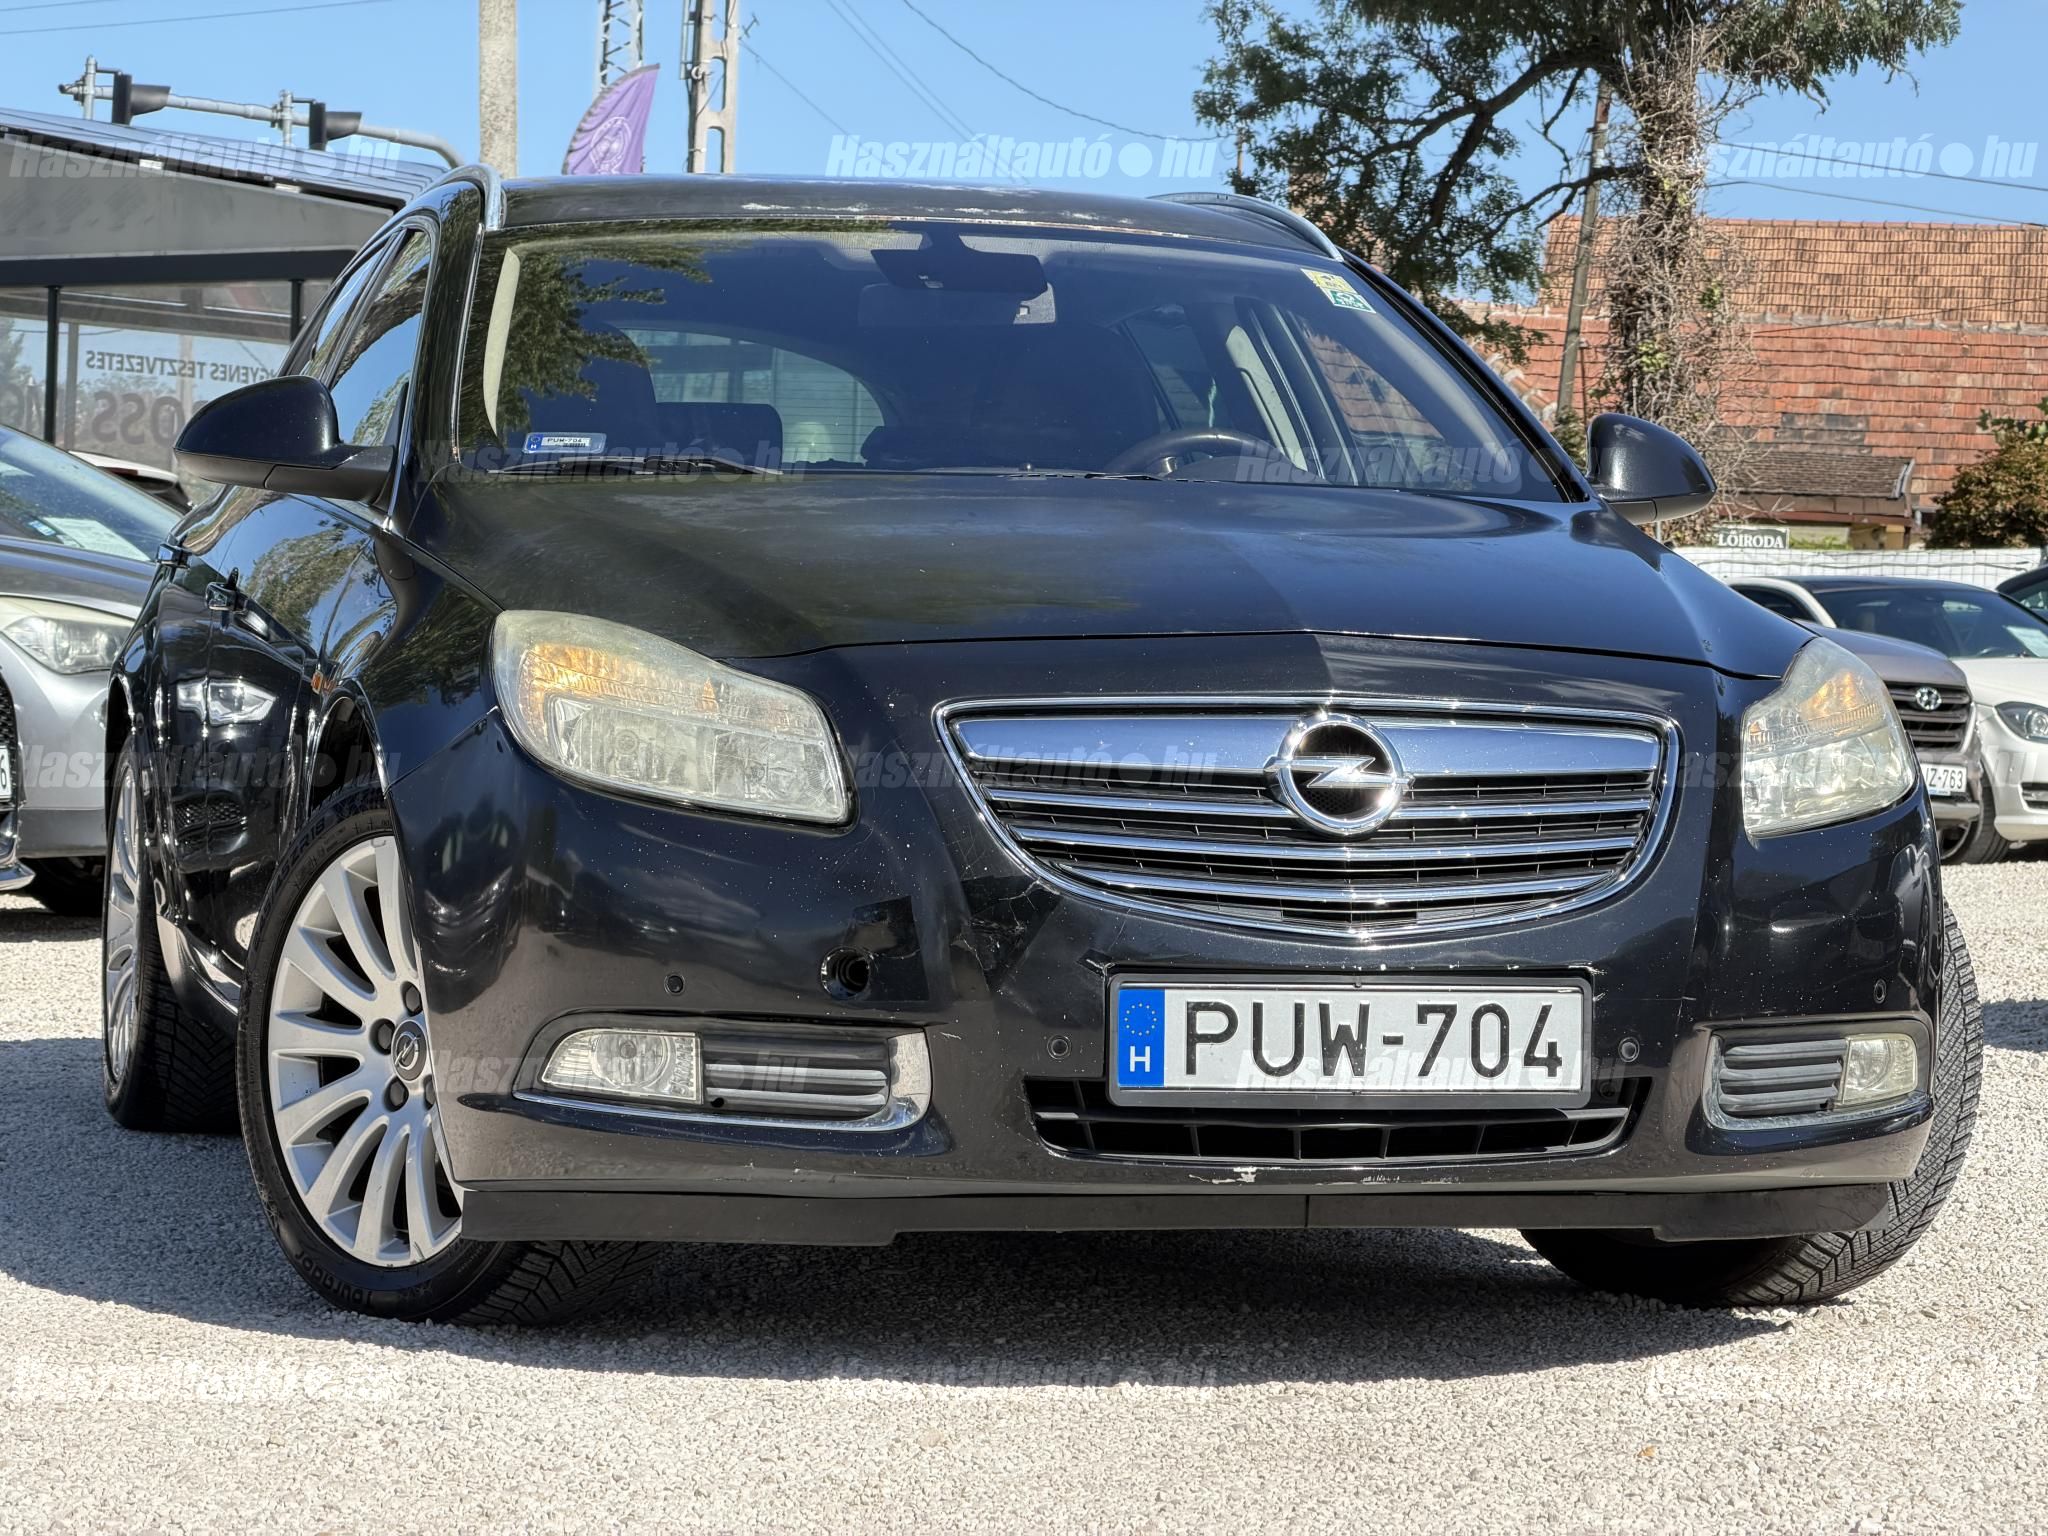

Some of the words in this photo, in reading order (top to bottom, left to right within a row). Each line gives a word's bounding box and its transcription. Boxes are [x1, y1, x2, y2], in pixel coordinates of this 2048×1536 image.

[1714, 530, 1784, 549] LŐIRODA
[1184, 1000, 1563, 1078] PUW-704
[1129, 1045, 1151, 1072] H
